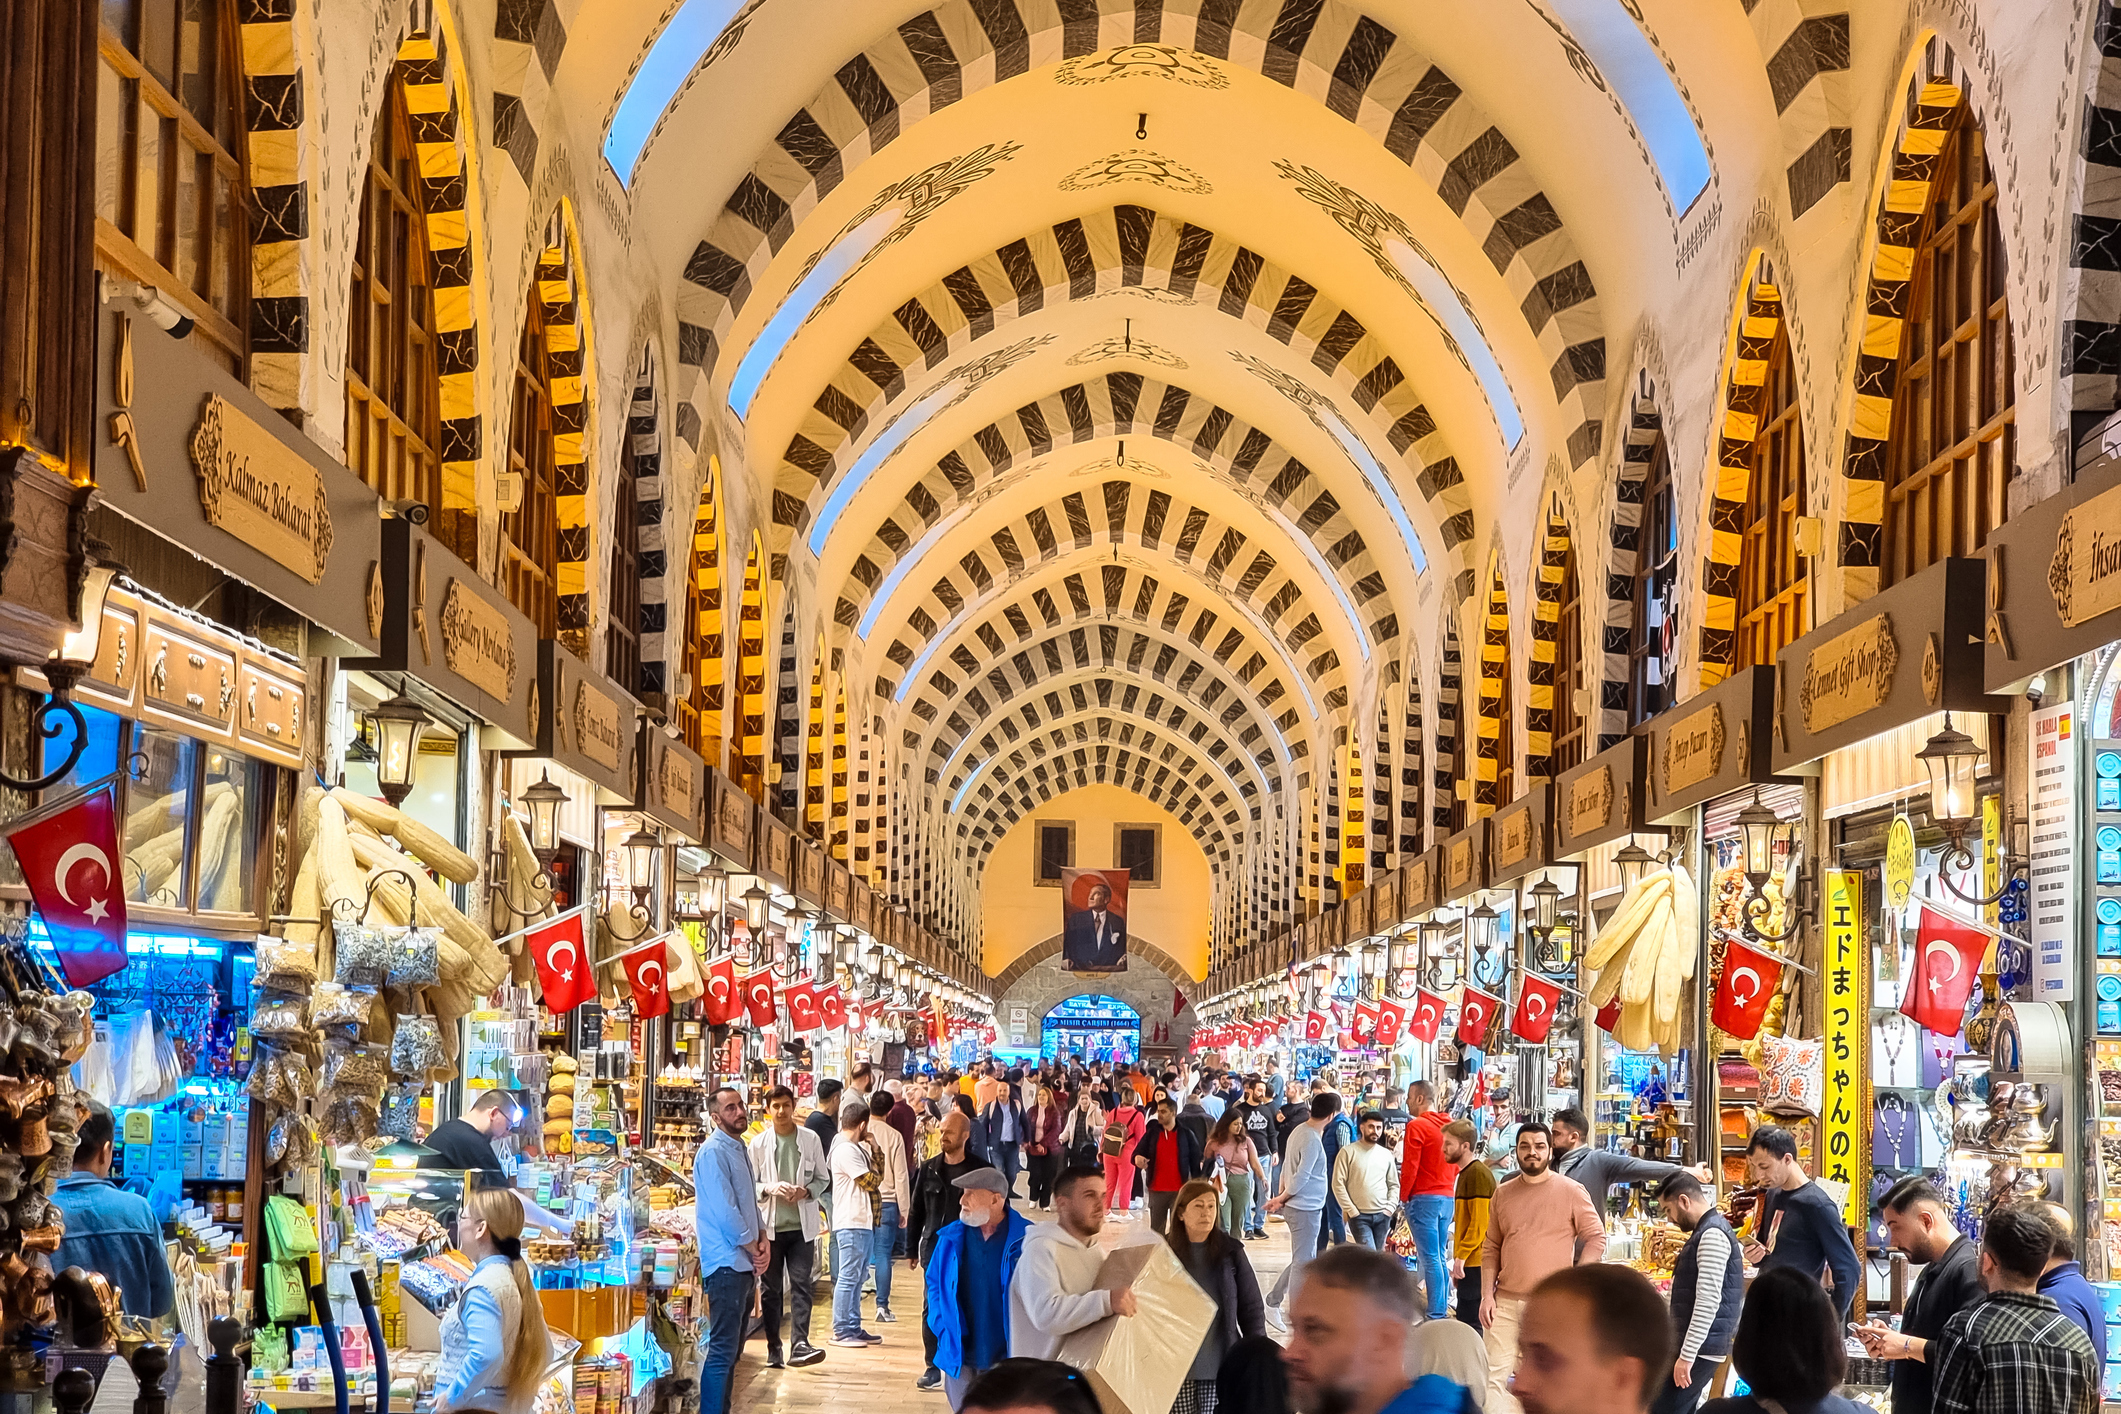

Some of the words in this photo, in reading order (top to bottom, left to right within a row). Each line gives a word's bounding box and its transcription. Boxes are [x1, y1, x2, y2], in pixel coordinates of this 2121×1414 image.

[224, 451, 269, 514] Kalmaz
[271, 482, 312, 542] Baharat
[1813, 662, 1838, 700] Cennet
[1839, 648, 1855, 698] Gift
[1855, 641, 1877, 689] Shop
[1923, 651, 1934, 683] 48
[2035, 720, 2043, 737] SE
[2042, 716, 2057, 736] HABLA
[1110, 1019, 1130, 1027] (1664)
[1829, 906, 1853, 1226] エドまっちゃんのみ
